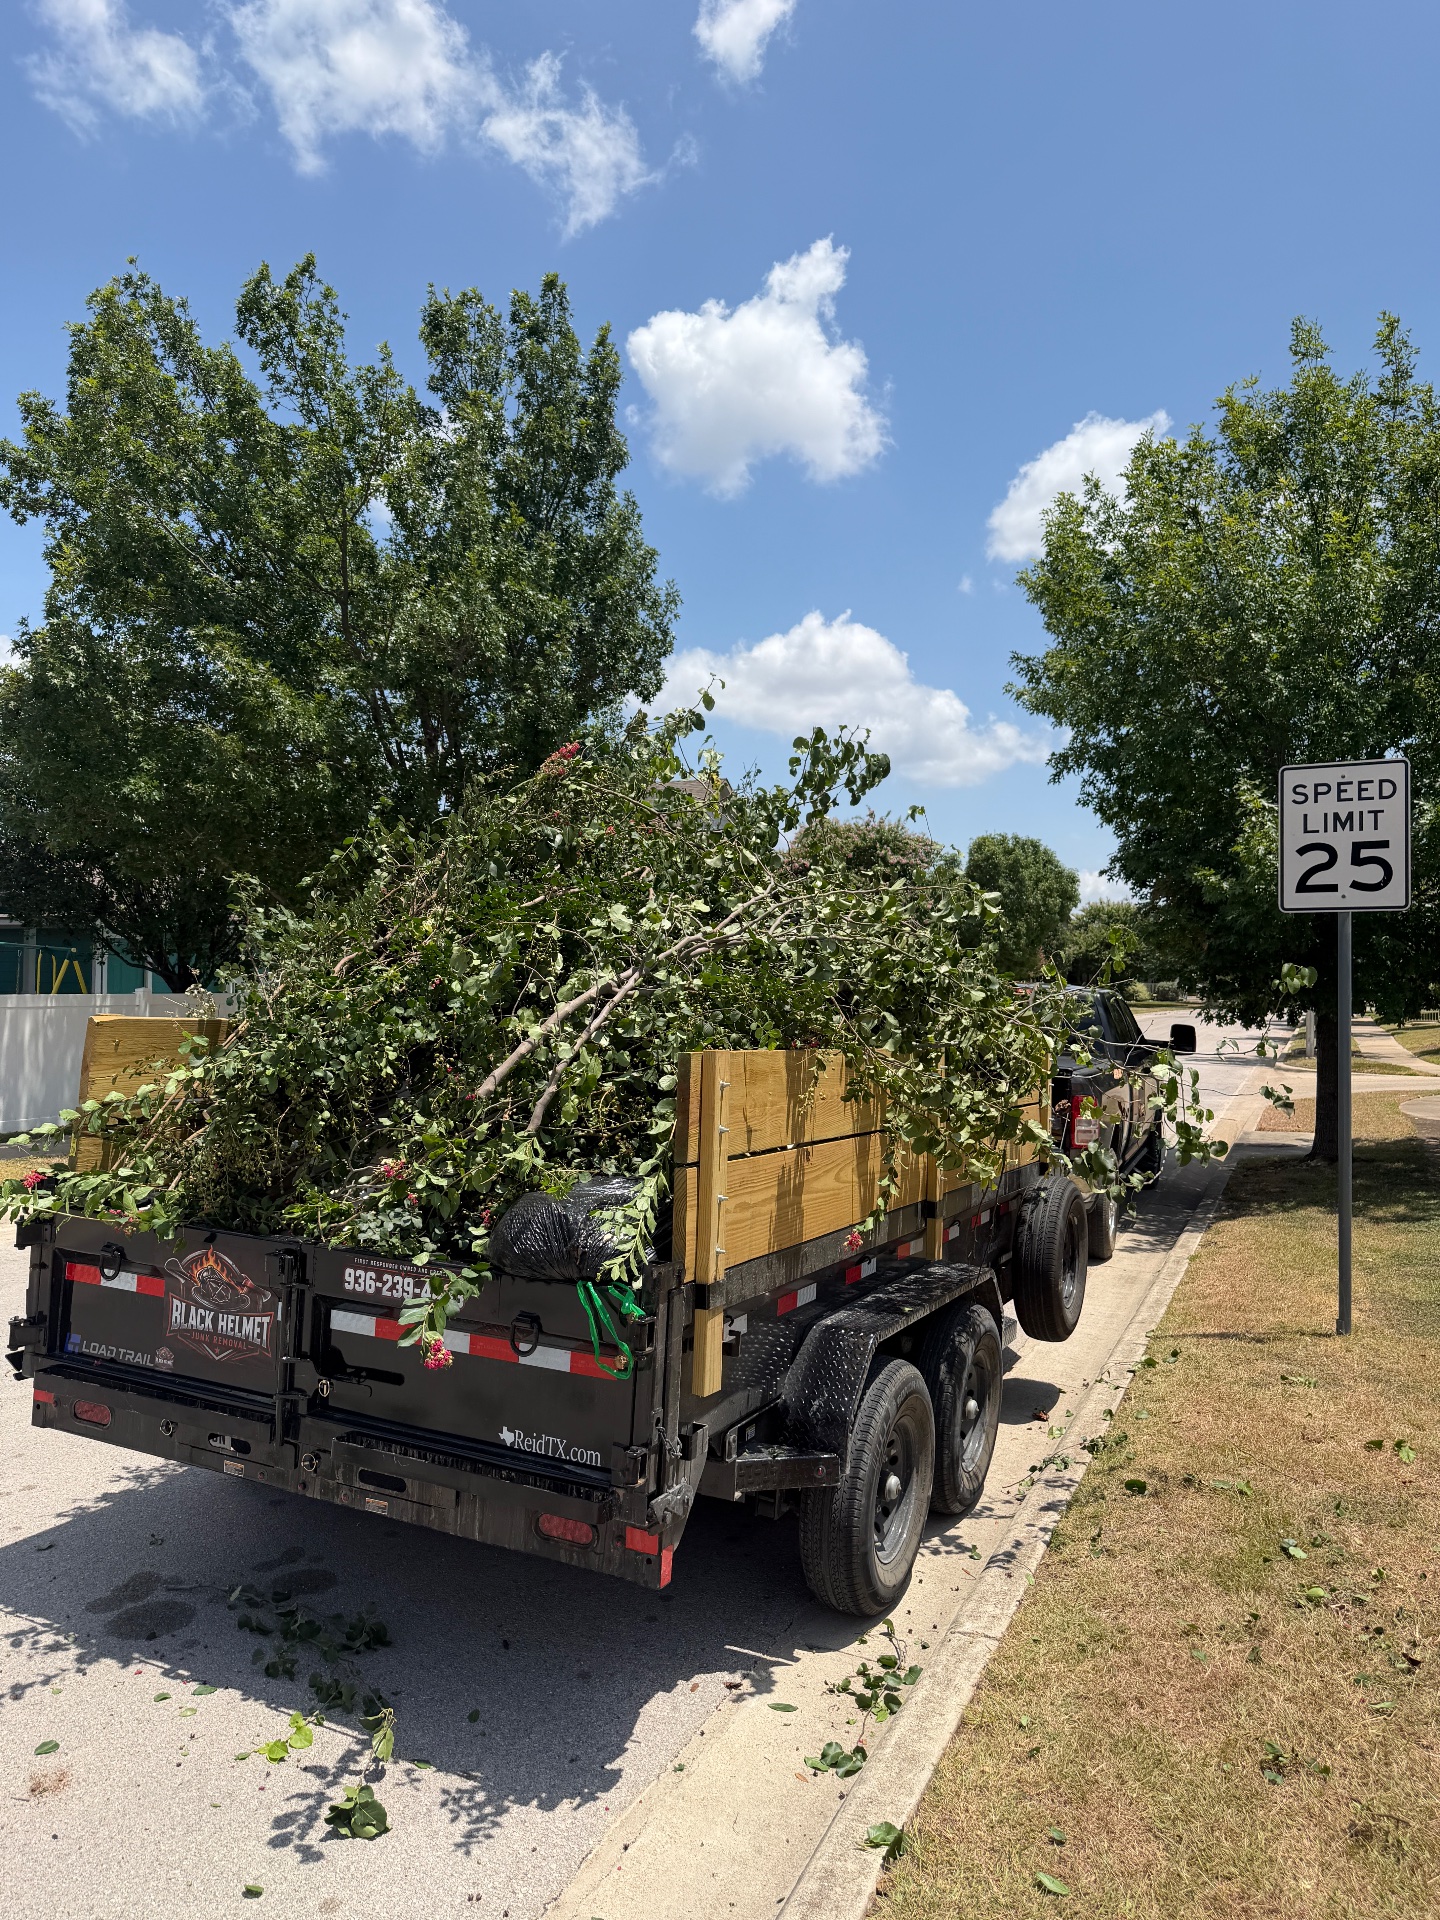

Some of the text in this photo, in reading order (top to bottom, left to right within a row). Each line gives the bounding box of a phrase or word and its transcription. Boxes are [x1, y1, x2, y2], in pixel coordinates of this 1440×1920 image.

[1291, 778, 1398, 805] SPEED
[1302, 809, 1385, 834] LIMIT
[1294, 839, 1394, 894] 25
[354, 1257, 369, 1265] FIRST
[370, 1260, 399, 1270] RESPONDER
[399, 1264, 416, 1273] OWNED
[344, 1267, 464, 1309] 936-239-4
[171, 1298, 271, 1349] BLACK HELMET
[82, 1340, 117, 1358] LOAD
[118, 1348, 154, 1367] TRAIL
[191, 1331, 247, 1350] JUNK REMOVAL
[513, 1429, 602, 1467] ReidTX.com
